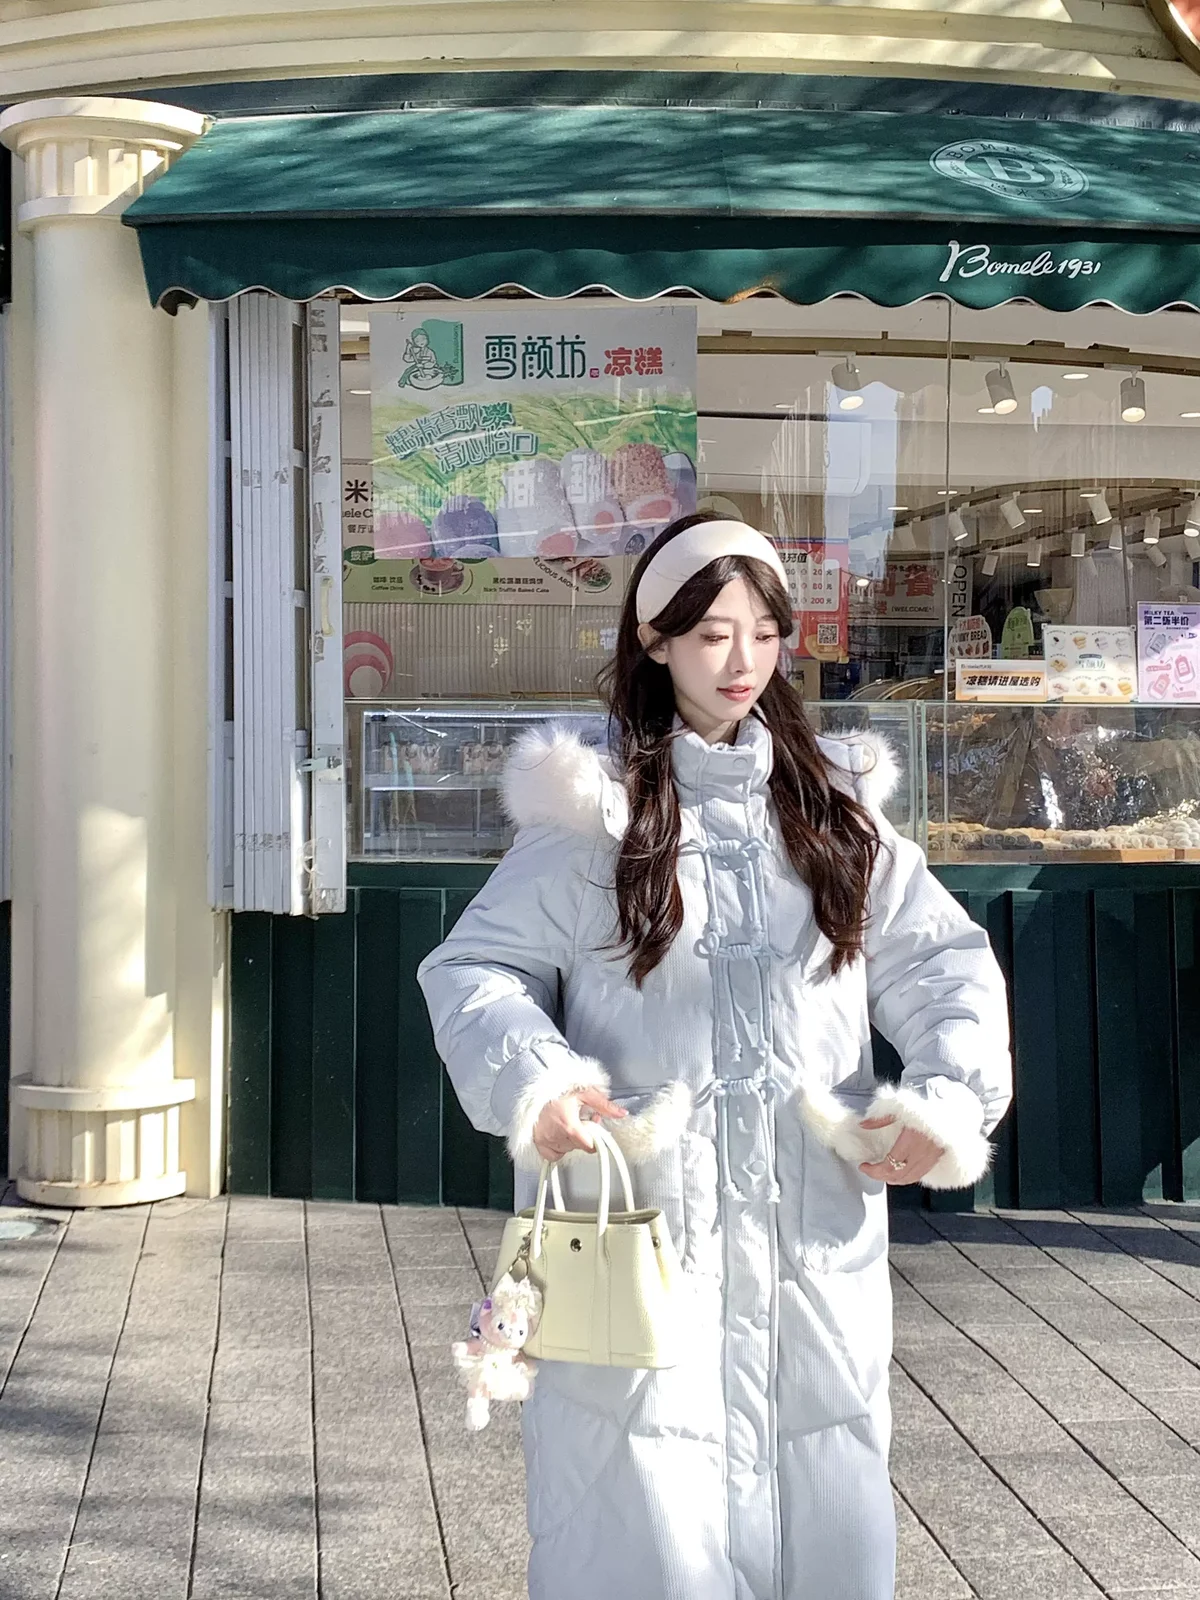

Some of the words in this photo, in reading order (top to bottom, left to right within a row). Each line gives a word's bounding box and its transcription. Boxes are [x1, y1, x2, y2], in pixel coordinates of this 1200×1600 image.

[977, 156, 1046, 183] B
[485, 335, 586, 380] 雪颜坊
[604, 347, 663, 376] 凉糕
[434, 427, 538, 475] 清心怡口
[344, 479, 373, 504] 米
[951, 565, 967, 617] OPEN
